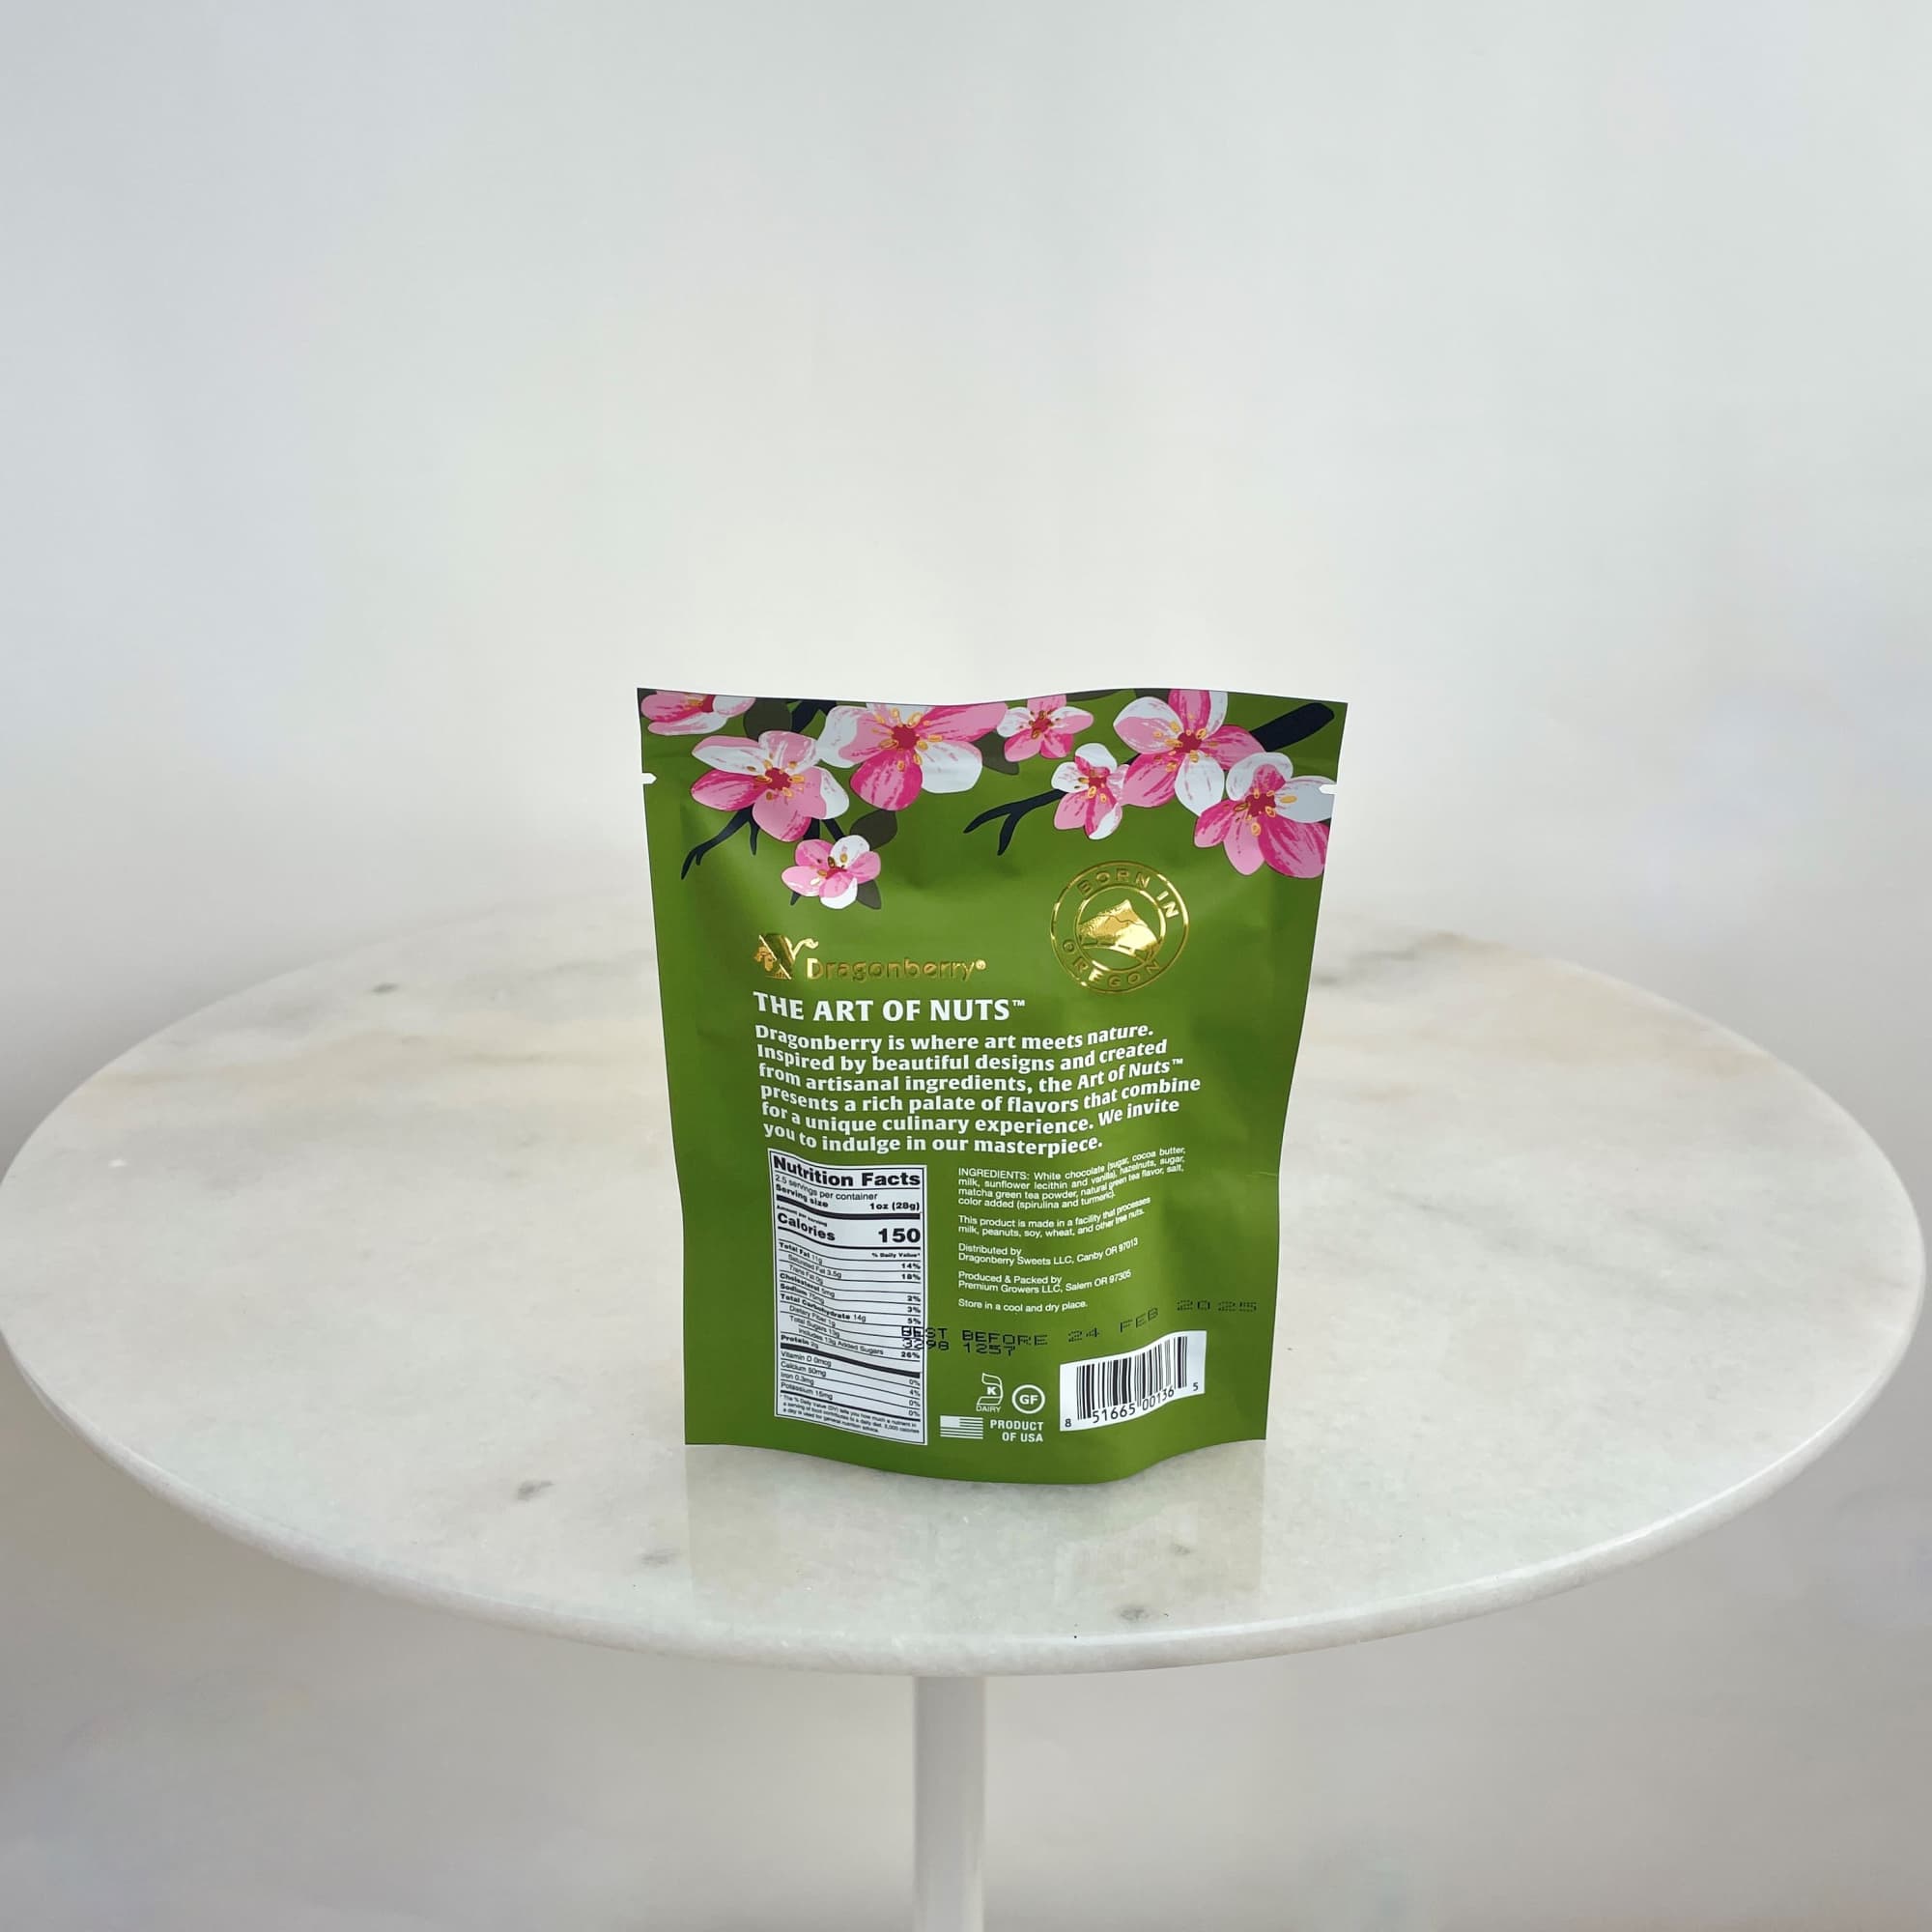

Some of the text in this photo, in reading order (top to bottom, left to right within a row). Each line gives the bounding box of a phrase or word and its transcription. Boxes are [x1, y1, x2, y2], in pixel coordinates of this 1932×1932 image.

[1077, 867, 1179, 920] BORN IN
[1062, 938, 1160, 987] OREGON
[753, 991, 804, 1020] THE
[813, 1000, 873, 1022] ART
[882, 999, 921, 1022] OF
[755, 1024, 1154, 1055] Dragonberry is where art meets nature.
[757, 1038, 1168, 1075] Inspired by beautiful designs and created
[759, 1062, 801, 1088] from
[806, 1075, 899, 1092] artisanal
[905, 1074, 1034, 1094] ingredients,
[1038, 1076, 1072, 1094] the
[1076, 1072, 1105, 1091] Art
[1108, 1064, 1126, 1083] of
[760, 1078, 1201, 1114] presents a rich palate of flavors that combine
[761, 1098, 1180, 1137] for a unique culinary experience. We invite
[763, 1122, 1103, 1159] you to indulge in our masterpiece.
[773, 1155, 921, 1187] Nutrition Facts
[958, 1167, 1030, 1181] INGREDIENTS:
[1034, 1172, 1062, 1180] White
[1065, 1164, 1105, 1180] chocolate
[1132, 1150, 1156, 1162] cocoa
[776, 1183, 809, 1201] Serving
[810, 1196, 829, 1208] size
[789, 1180, 818, 1196] servings
[820, 1188, 833, 1198] per
[836, 1190, 878, 1201] container
[958, 1178, 980, 1189] milk,
[984, 1179, 1030, 1191] sunflower
[1035, 1181, 1068, 1190] lecithin
[1071, 1178, 1089, 1189] and
[958, 1188, 993, 1198] matcha
[996, 1191, 1022, 1201] green
[1042, 1190, 1079, 1202] powder,
[1081, 1180, 1108, 1197] natural
[1109, 1176, 1127, 1190] green
[1128, 1172, 1141, 1181] tea
[958, 1198, 982, 1208] color
[984, 1200, 1014, 1209] added
[1017, 1201, 1060, 1211] (spirulina
[1062, 1199, 1079, 1208] and
[958, 1214, 979, 1226] This
[980, 1217, 1015, 1229] product
[1018, 1219, 1025, 1228] is
[1028, 1219, 1055, 1229] made
[1057, 1218, 1065, 1227] in
[1075, 1212, 1101, 1226] facility
[1117, 1197, 1151, 1215] processes
[778, 1212, 921, 1243] Calories 150
[958, 1226, 980, 1236] milk,
[1077, 1224, 1094, 1236] and
[1095, 1218, 1116, 1232] other
[780, 1241, 798, 1253] Total
[958, 1242, 1022, 1258] Distributed by
[958, 1236, 1139, 1267] Dragonberry Sweets LLC, Canby OR 97013
[958, 1270, 1063, 1287] Produced & Packed by
[958, 1281, 999, 1293] Premium
[1001, 1284, 1039, 1294] Growers
[1042, 1285, 1064, 1293] LLC,
[1065, 1280, 1093, 1293] Salem
[1094, 1277, 1108, 1288] OR
[781, 1293, 800, 1304] Total
[958, 1298, 982, 1310] Store
[1004, 1304, 1023, 1313] cool
[1045, 1304, 1060, 1314] dry
[1063, 1301, 1089, 1312] place.
[901, 1326, 947, 1341] BEST
[962, 1330, 1048, 1348] BEFORE
[1120, 1308, 1159, 1333] FEB
[1019, 1395, 1038, 1406] GF
[1065, 1418, 1071, 1428] 8
[1092, 1403, 1136, 1424] 51665
[1193, 1382, 1199, 1392] 5
[990, 1418, 1044, 1432] PRODUCT
[1002, 1432, 1044, 1443] OF USA
